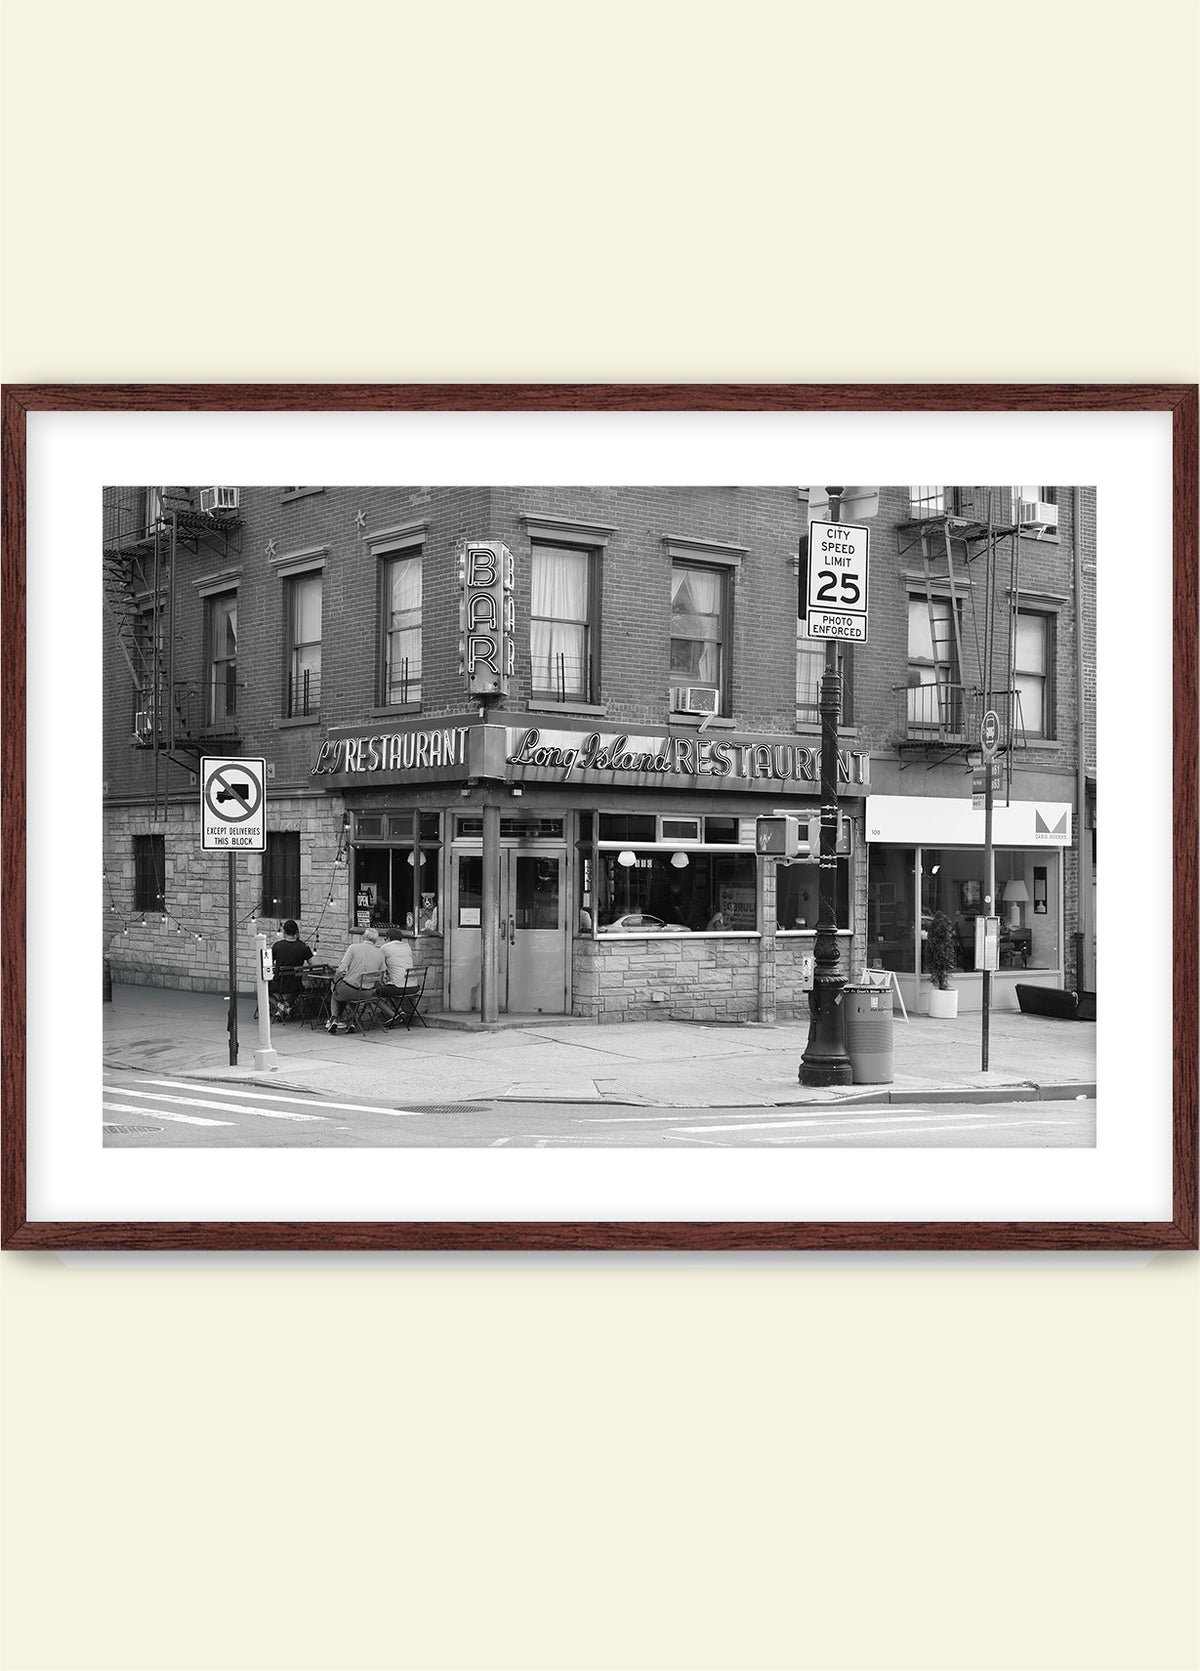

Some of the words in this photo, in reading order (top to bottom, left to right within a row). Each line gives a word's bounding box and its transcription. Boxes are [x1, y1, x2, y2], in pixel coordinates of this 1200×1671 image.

[826, 528, 850, 540] CITY
[821, 541, 855, 554] SPEED
[824, 556, 852, 567] LIMIT
[816, 570, 861, 604] 25
[467, 548, 499, 674] BAR
[822, 615, 853, 626] PHOTO
[812, 624, 862, 637] ENFORCED
[344, 726, 469, 773] RESTAURANT
[510, 727, 579, 780] Long
[580, 732, 672, 773] Island
[206, 826, 227, 836] EXCEPT
[228, 826, 261, 836] DELIVERIES
[214, 837, 229, 846] THIS
[231, 837, 254, 846] BLOCK
